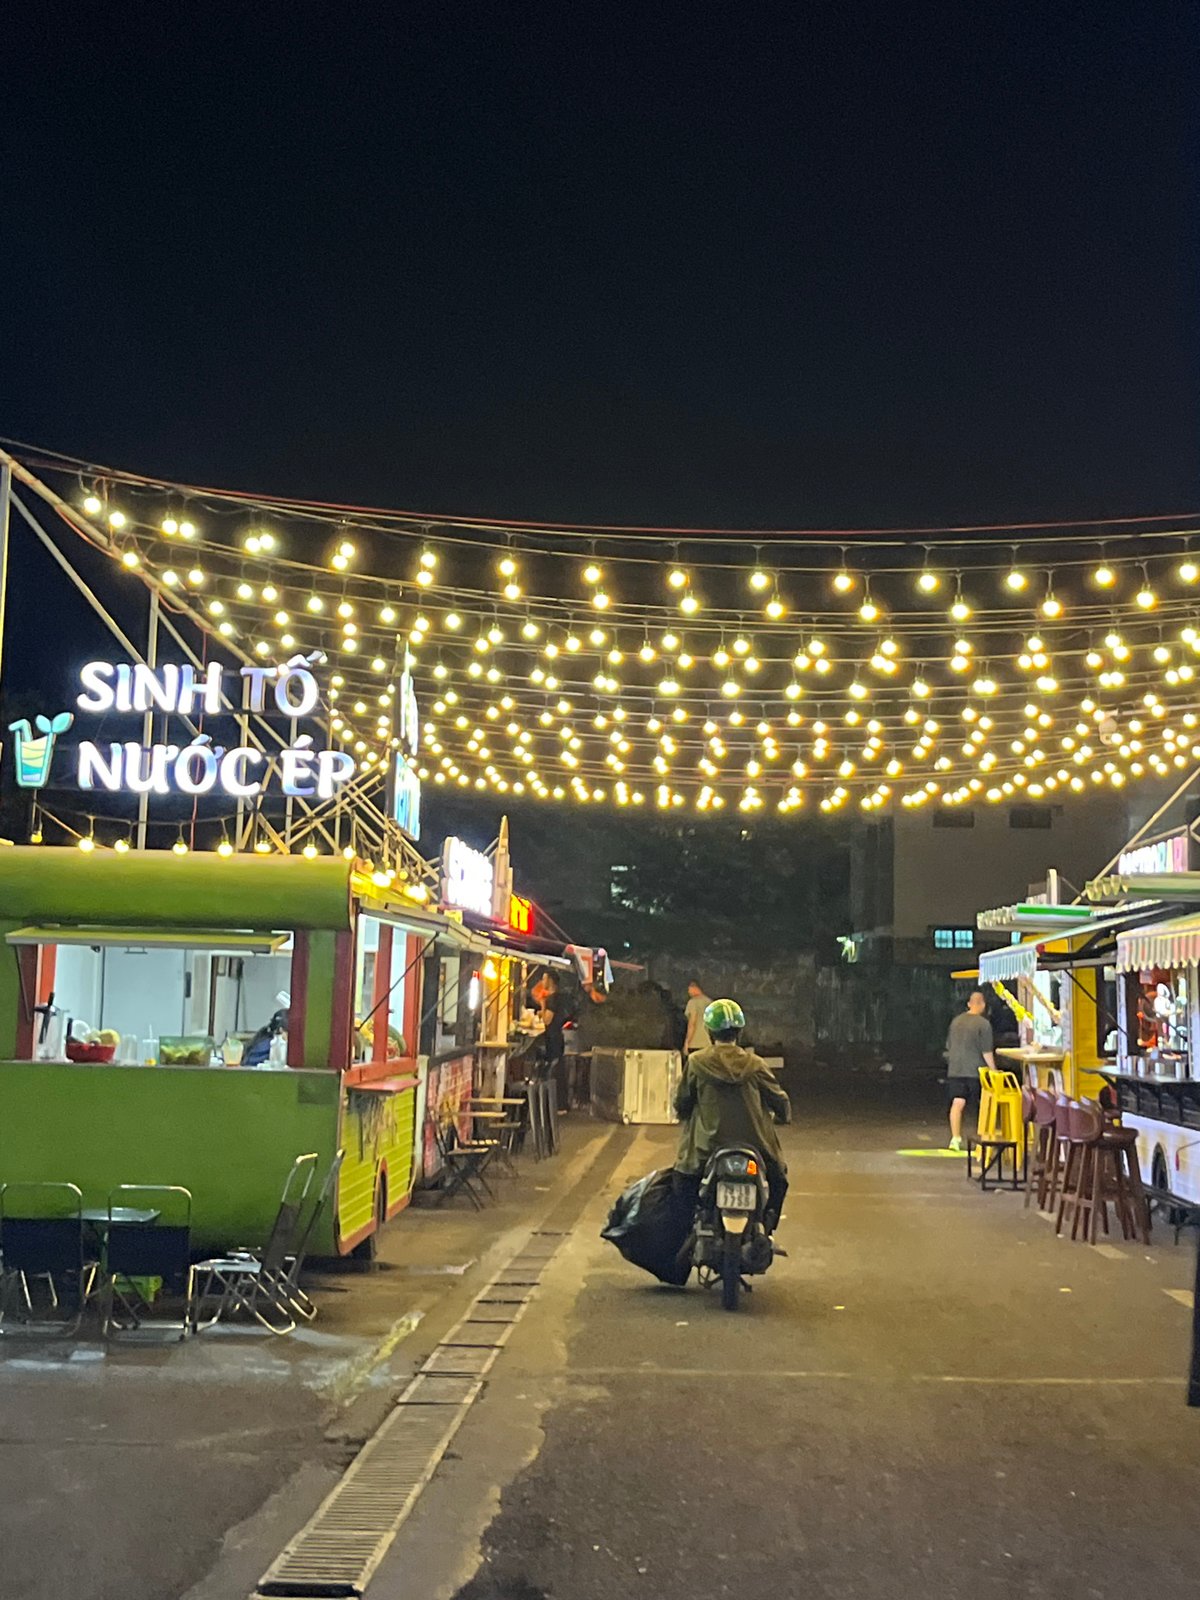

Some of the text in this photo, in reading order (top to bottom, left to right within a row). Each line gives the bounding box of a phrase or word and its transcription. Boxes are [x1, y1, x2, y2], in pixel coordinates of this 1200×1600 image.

[77, 650, 325, 717] SINH TỐ
[78, 734, 262, 796] NƯỚC
[280, 734, 356, 799] ÉP
